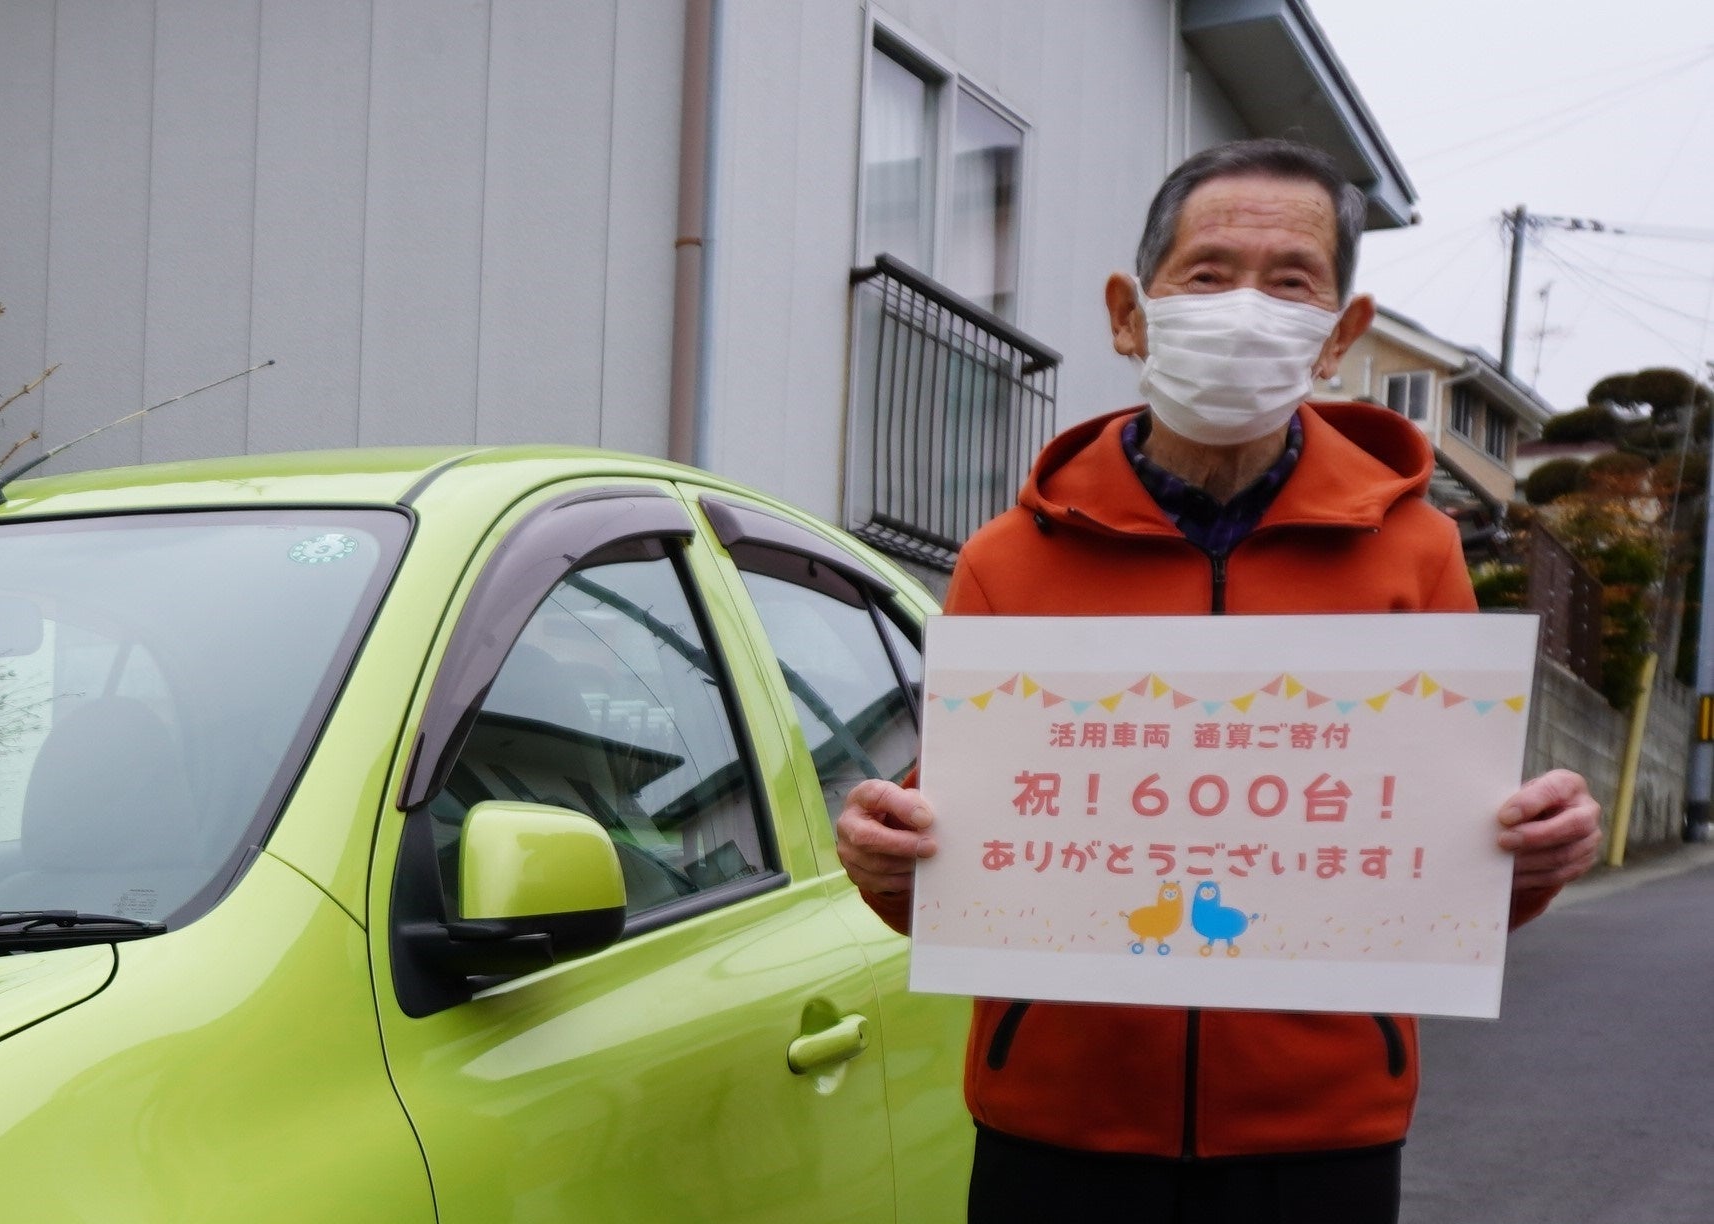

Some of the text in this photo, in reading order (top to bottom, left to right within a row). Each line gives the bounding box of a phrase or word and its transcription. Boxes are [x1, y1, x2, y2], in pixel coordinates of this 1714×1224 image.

[1050, 722, 1351, 750] 活用車両 通算ご寄付
[982, 839, 1425, 880] ありがとうございます！
